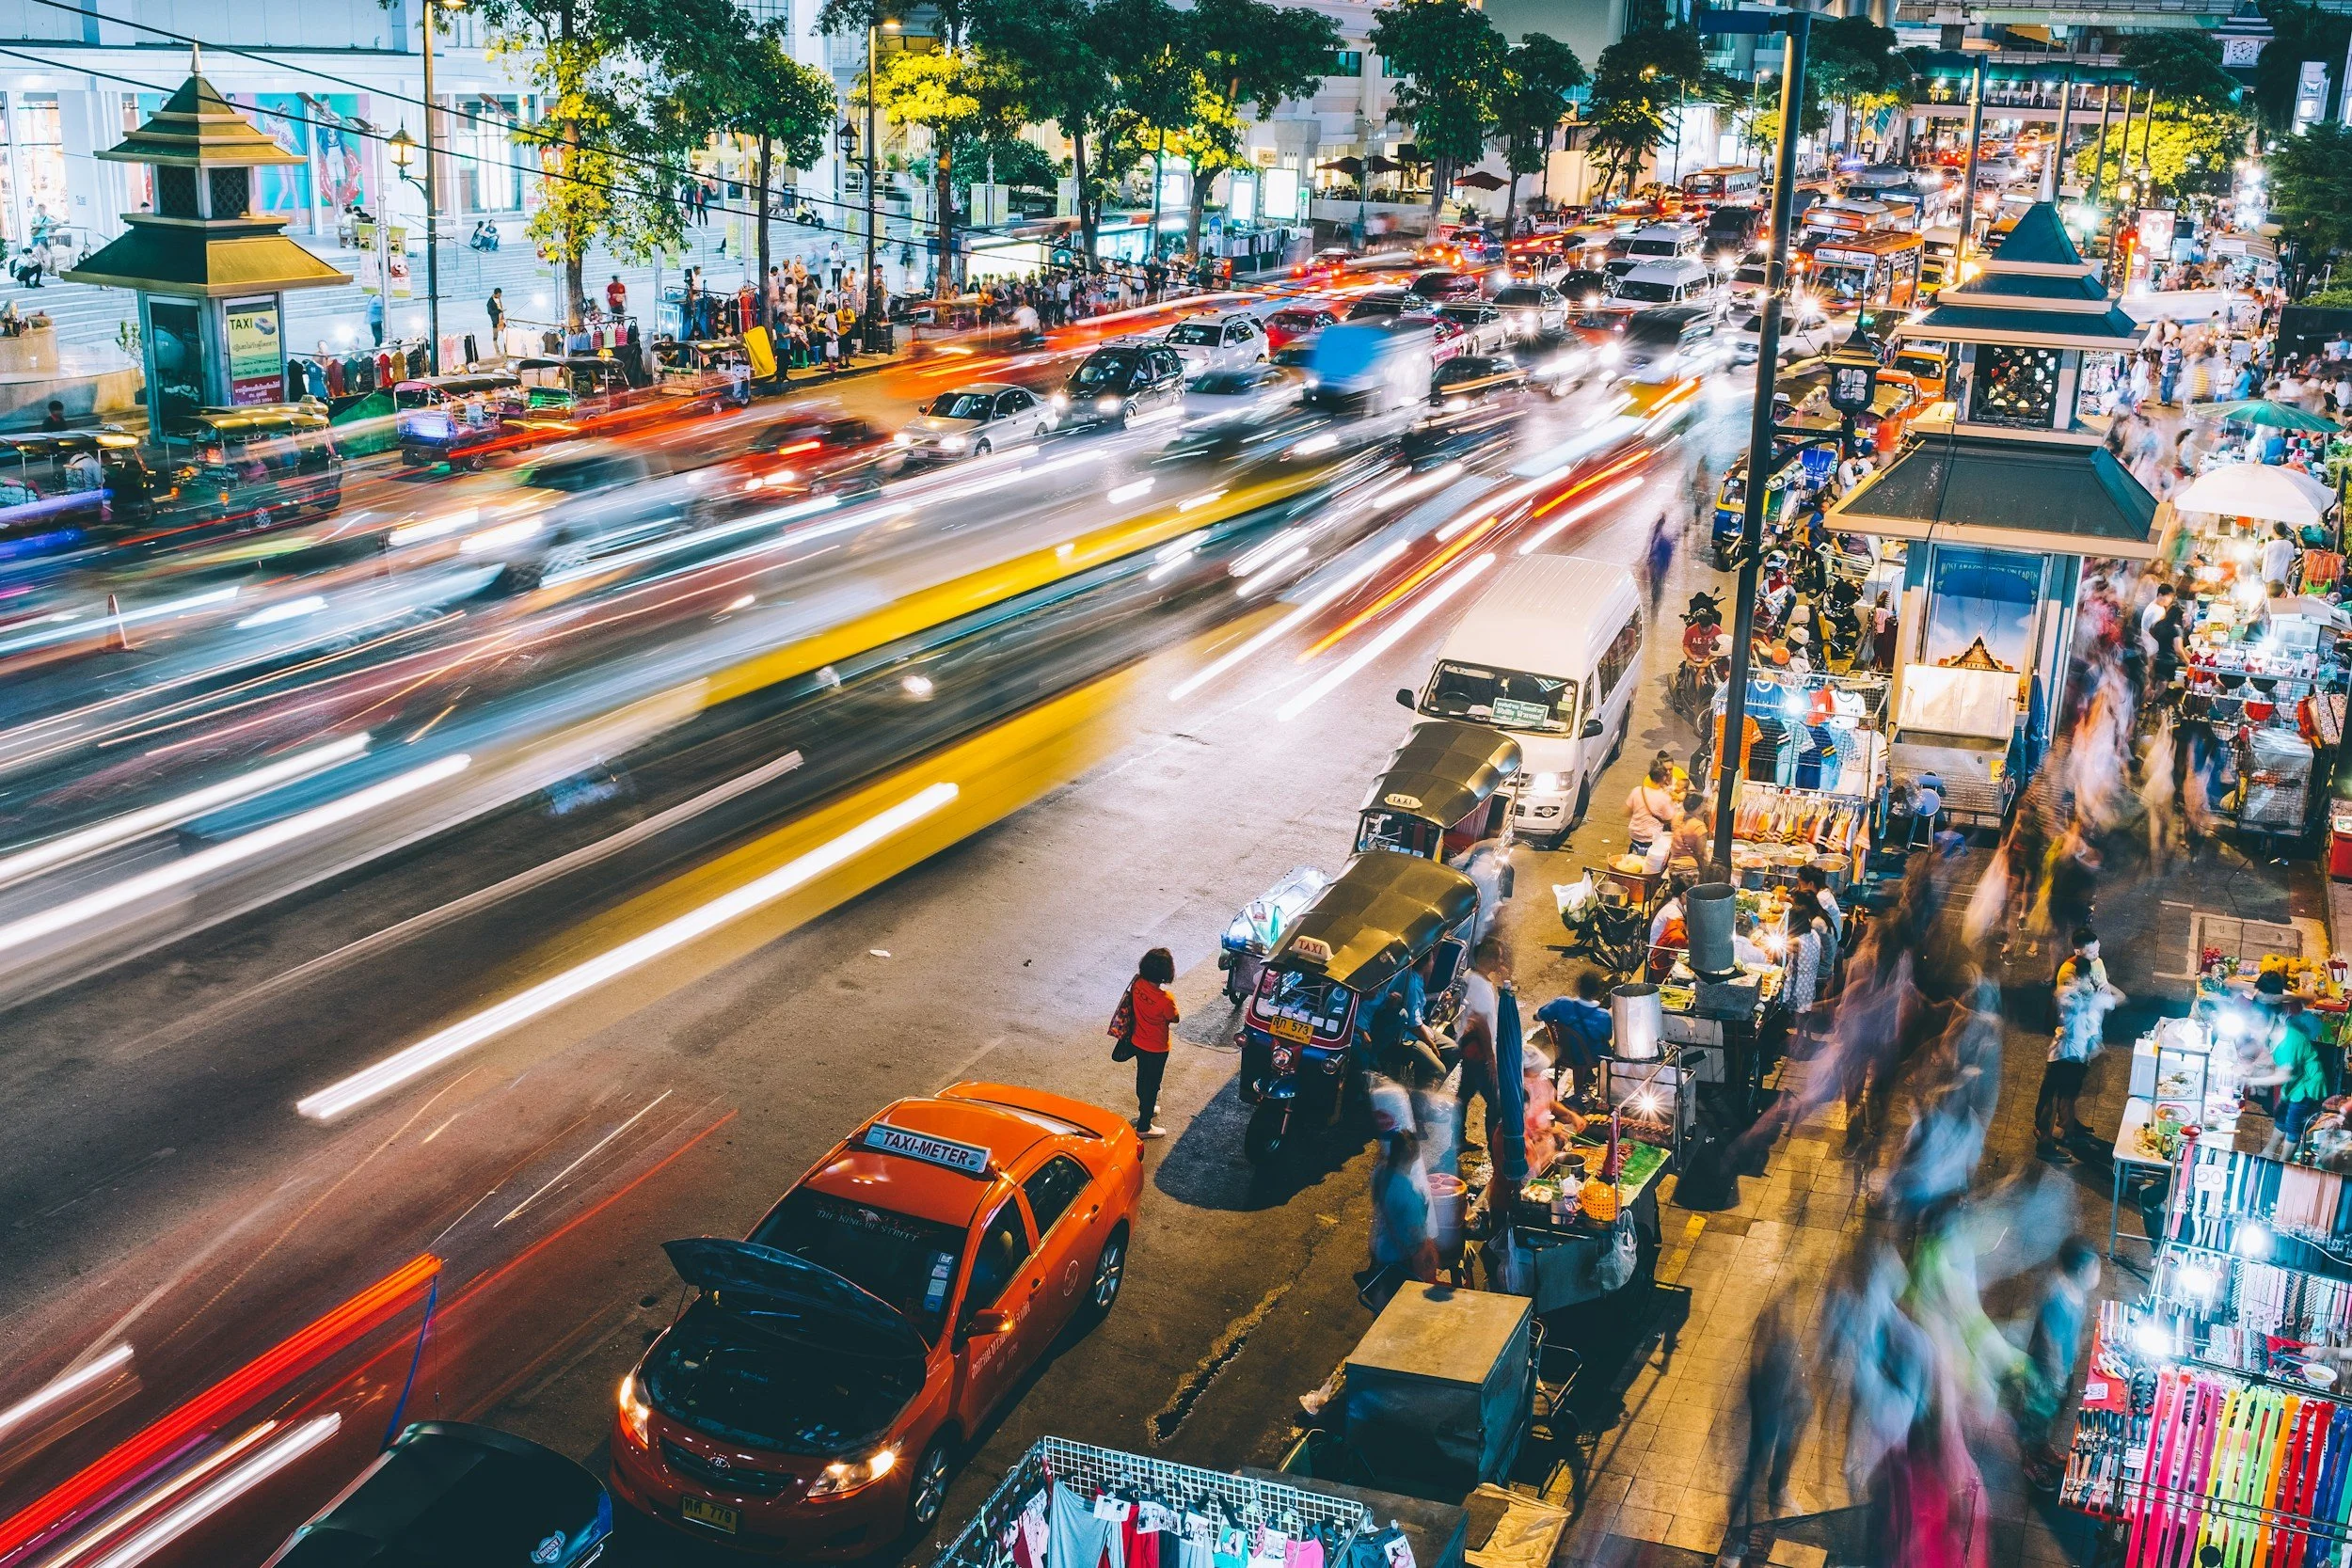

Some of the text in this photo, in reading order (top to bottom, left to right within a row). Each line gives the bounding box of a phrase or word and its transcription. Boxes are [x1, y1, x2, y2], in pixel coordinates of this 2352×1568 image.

[2049, 11, 2088, 22] Bangkok
[230, 318, 253, 330] TAXI
[2017, 570, 2039, 581] EARTH
[1392, 796, 1412, 805] TAXI
[1298, 940, 1323, 955] TAXI
[1292, 1023, 1310, 1036] 573
[883, 1131, 970, 1166] TAXI-METER
[2196, 1167, 2223, 1185] 50
[881, 1225, 920, 1243] STREET
